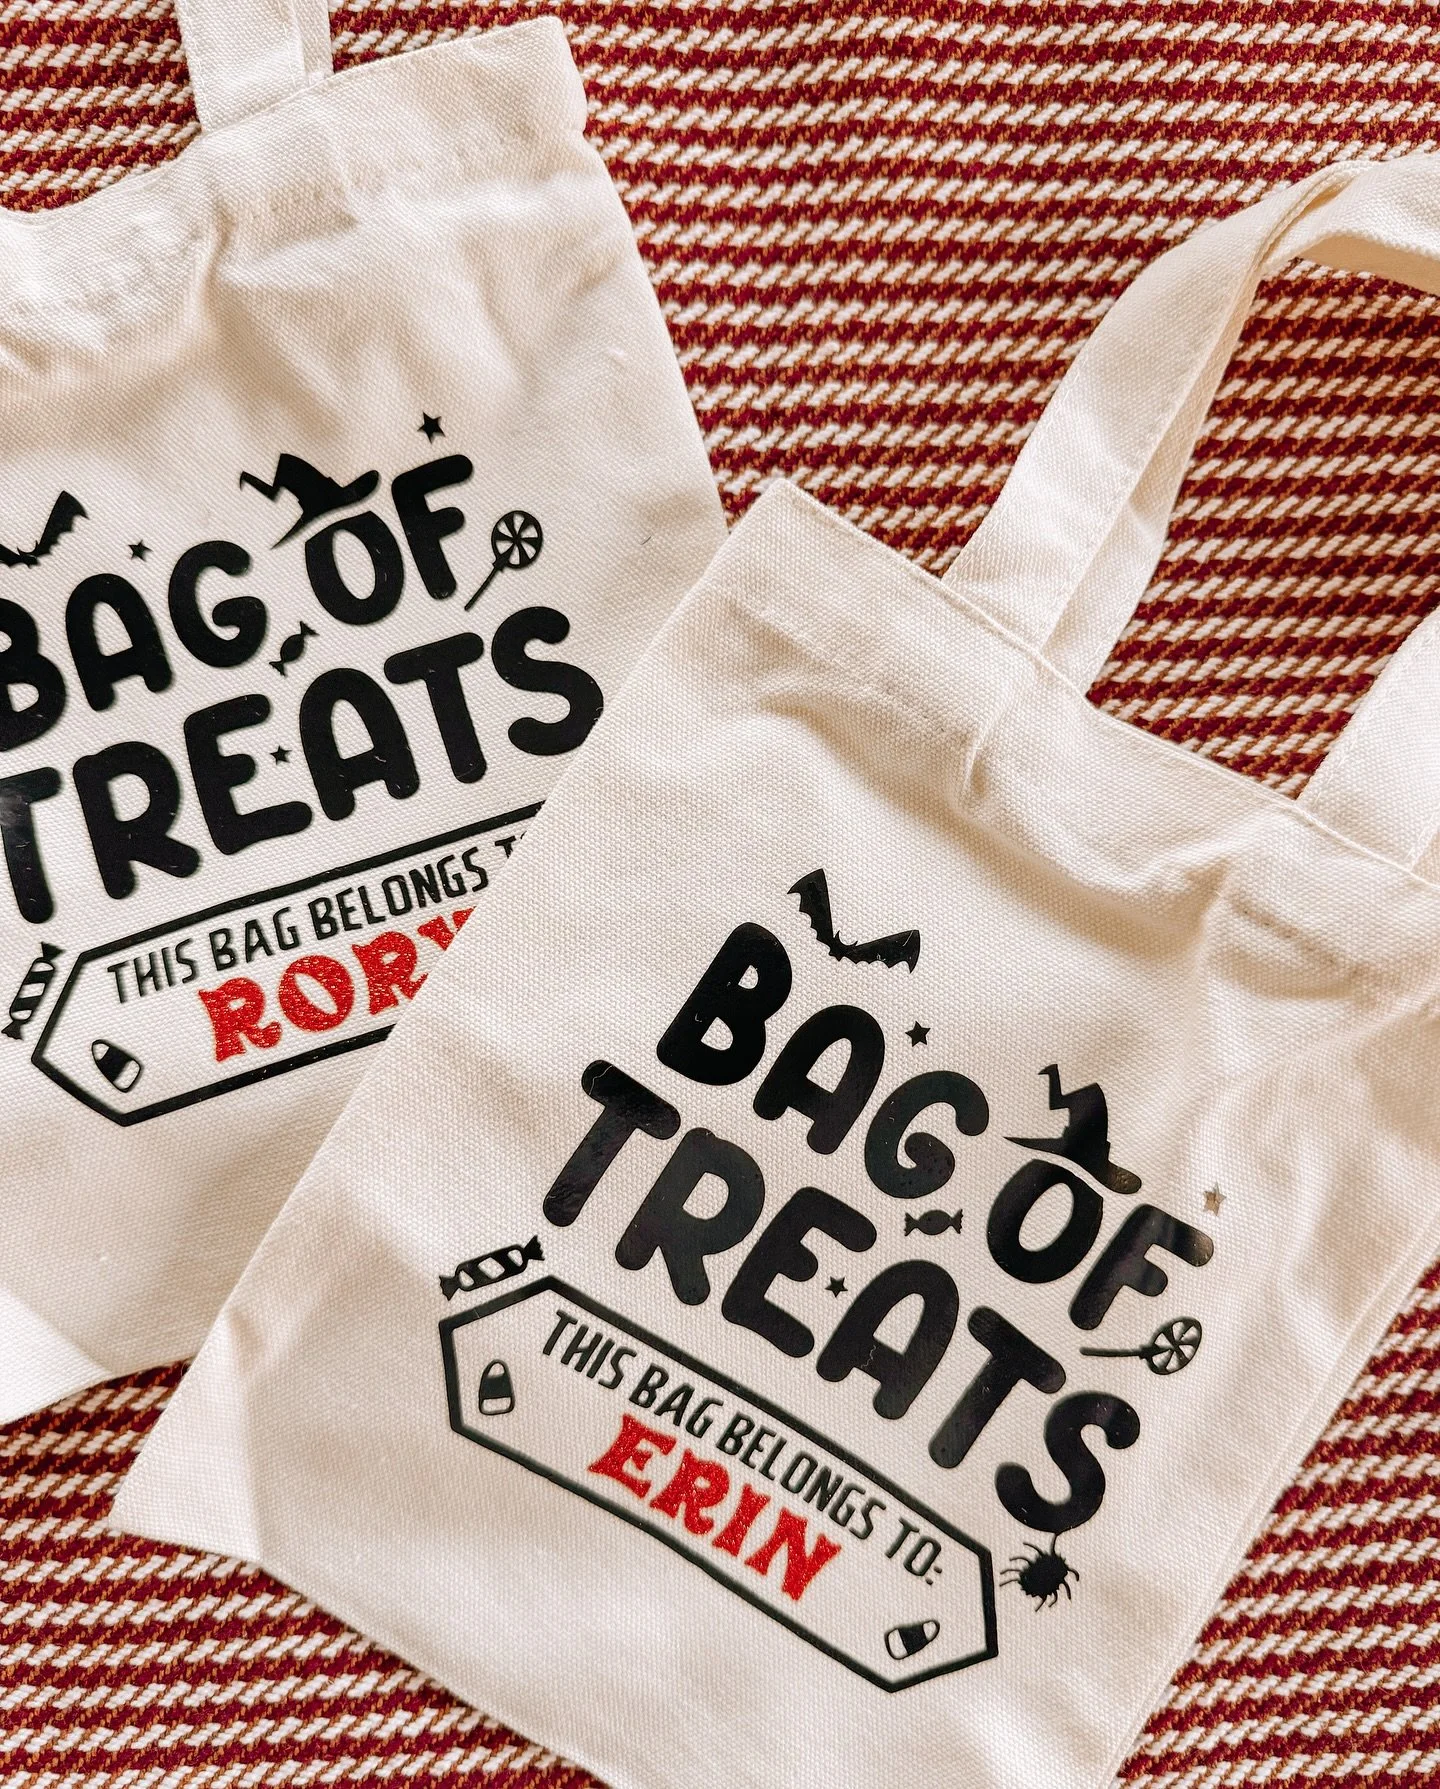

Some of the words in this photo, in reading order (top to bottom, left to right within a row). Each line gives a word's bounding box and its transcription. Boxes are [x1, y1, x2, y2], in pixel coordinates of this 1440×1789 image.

[0, 540, 268, 752] BAG
[305, 454, 473, 626] OF
[0, 606, 604, 926] TREATS
[106, 937, 199, 1004] THIS
[208, 906, 301, 971] BAG
[307, 846, 489, 941] BELONGS
[657, 922, 989, 1199] BAG
[986, 1158, 1215, 1331] OF
[543, 1060, 1141, 1535] TREATS
[542, 1309, 638, 1390] THIS
[628, 1363, 724, 1439] BAG
[715, 1412, 887, 1541] BELONGS
[885, 1517, 945, 1586] TO:
[588, 1413, 841, 1602] ERIN
